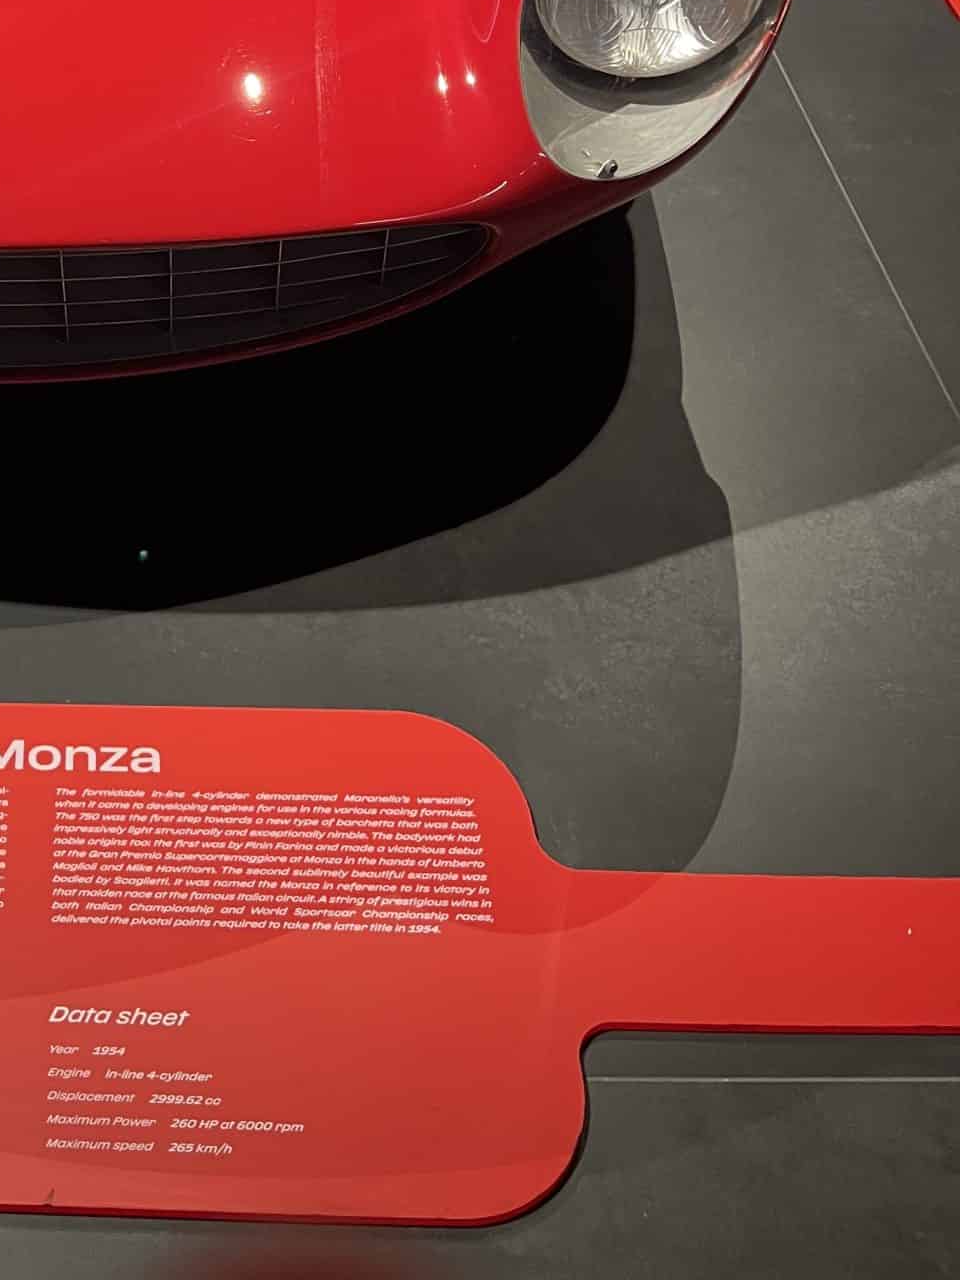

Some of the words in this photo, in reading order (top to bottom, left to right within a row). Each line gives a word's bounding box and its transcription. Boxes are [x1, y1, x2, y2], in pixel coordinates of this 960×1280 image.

[56, 787, 77, 796] The
[81, 788, 146, 798] formidable
[151, 790, 186, 799] in-line
[191, 791, 250, 800] 4-cylinder
[255, 792, 338, 802] demonstrated
[343, 794, 411, 804] Maranello's
[416, 796, 475, 807] versatility
[53, 823, 127, 835] impressively
[127, 825, 154, 836] light
[153, 827, 224, 838] structurally
[223, 828, 248, 837] and
[248, 829, 326, 840] exceptionally
[371, 831, 394, 840] The
[394, 832, 456, 842] bodywork
[456, 833, 481, 843] had
[52, 861, 98, 872] Maglioli
[99, 863, 124, 872] and
[125, 863, 153, 872] Mike
[221, 865, 243, 875] The
[245, 867, 291, 876] second
[292, 868, 350, 879] sublimely
[350, 869, 406, 880] beautiful
[407, 871, 459, 882] example
[461, 874, 488, 882] was
[51, 901, 80, 910] both
[85, 902, 122, 911] Italian
[128, 903, 215, 915] Championship
[220, 906, 246, 914] and
[250, 906, 289, 916] World
[293, 907, 357, 918] Sportscar
[361, 909, 449, 922] Championship
[49, 1006, 112, 1024] Data
[116, 1008, 190, 1026] sheet
[49, 1046, 79, 1054] Year
[92, 1047, 125, 1055] 1954
[48, 1067, 91, 1079] Engine
[147, 1071, 212, 1082] 4-cylinder
[48, 1091, 134, 1104] Displacement
[149, 1094, 202, 1104] 2999.62
[47, 1115, 110, 1126] Maximum
[113, 1117, 156, 1127] Power
[171, 1119, 197, 1129] 260
[199, 1119, 218, 1129] HP
[220, 1122, 235, 1130] at
[236, 1121, 272, 1131] 6000
[274, 1124, 304, 1133] rpm
[47, 1138, 110, 1150] Maximum
[112, 1141, 153, 1152] speed
[169, 1143, 193, 1152] 265
[195, 1143, 232, 1156] km/h
